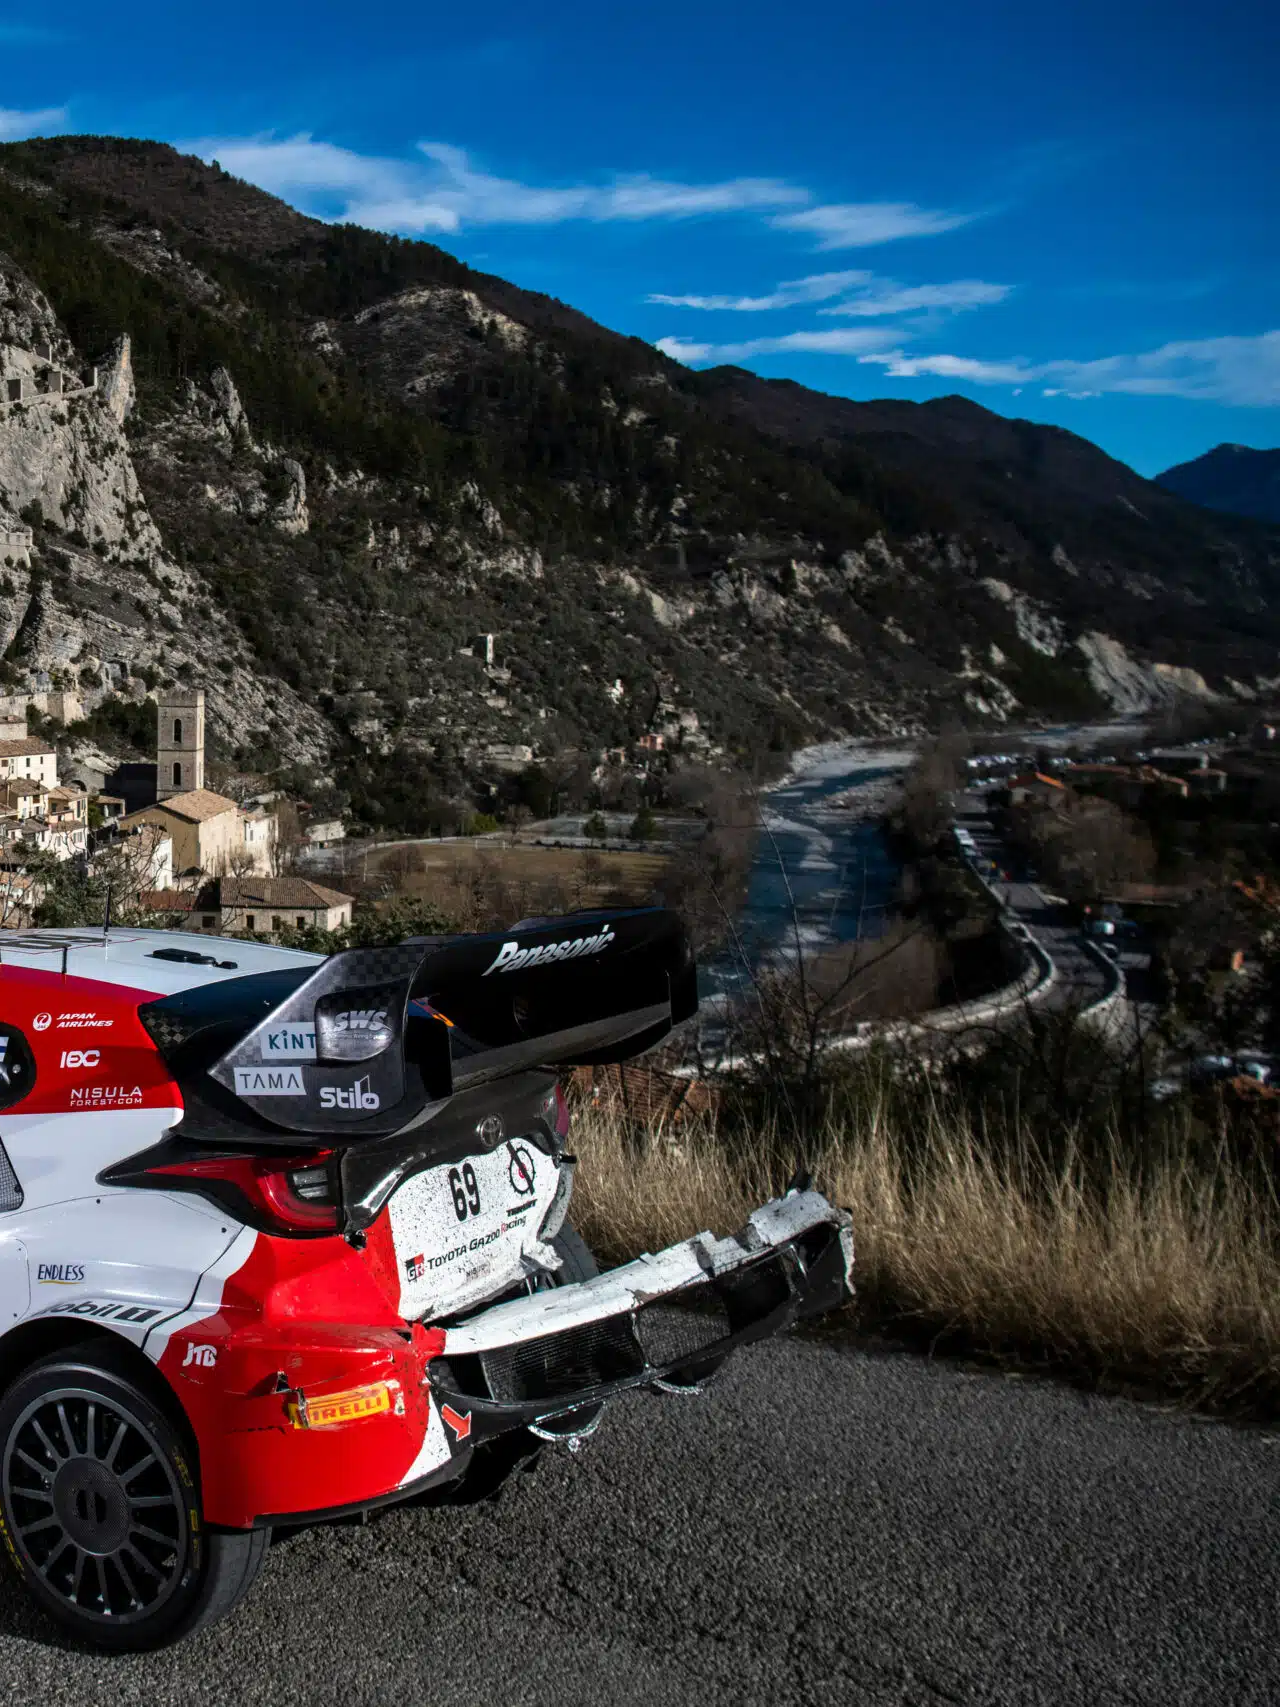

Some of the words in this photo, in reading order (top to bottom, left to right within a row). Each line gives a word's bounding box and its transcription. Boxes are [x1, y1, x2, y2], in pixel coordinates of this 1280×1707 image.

[481, 924, 615, 976] Panasonic
[56, 1012, 96, 1020] JAPAN
[56, 1020, 114, 1029] AIRLINES
[333, 1010, 387, 1031] SWS
[239, 1073, 300, 1089] TAMA
[70, 1086, 143, 1099] NISULA
[319, 1078, 380, 1110] Stilo
[448, 1162, 481, 1222] 69
[427, 1245, 467, 1270] TOYOTA
[470, 1228, 501, 1251] GAZOO
[501, 1215, 527, 1233] Racing
[37, 1264, 85, 1281] ENDLESS
